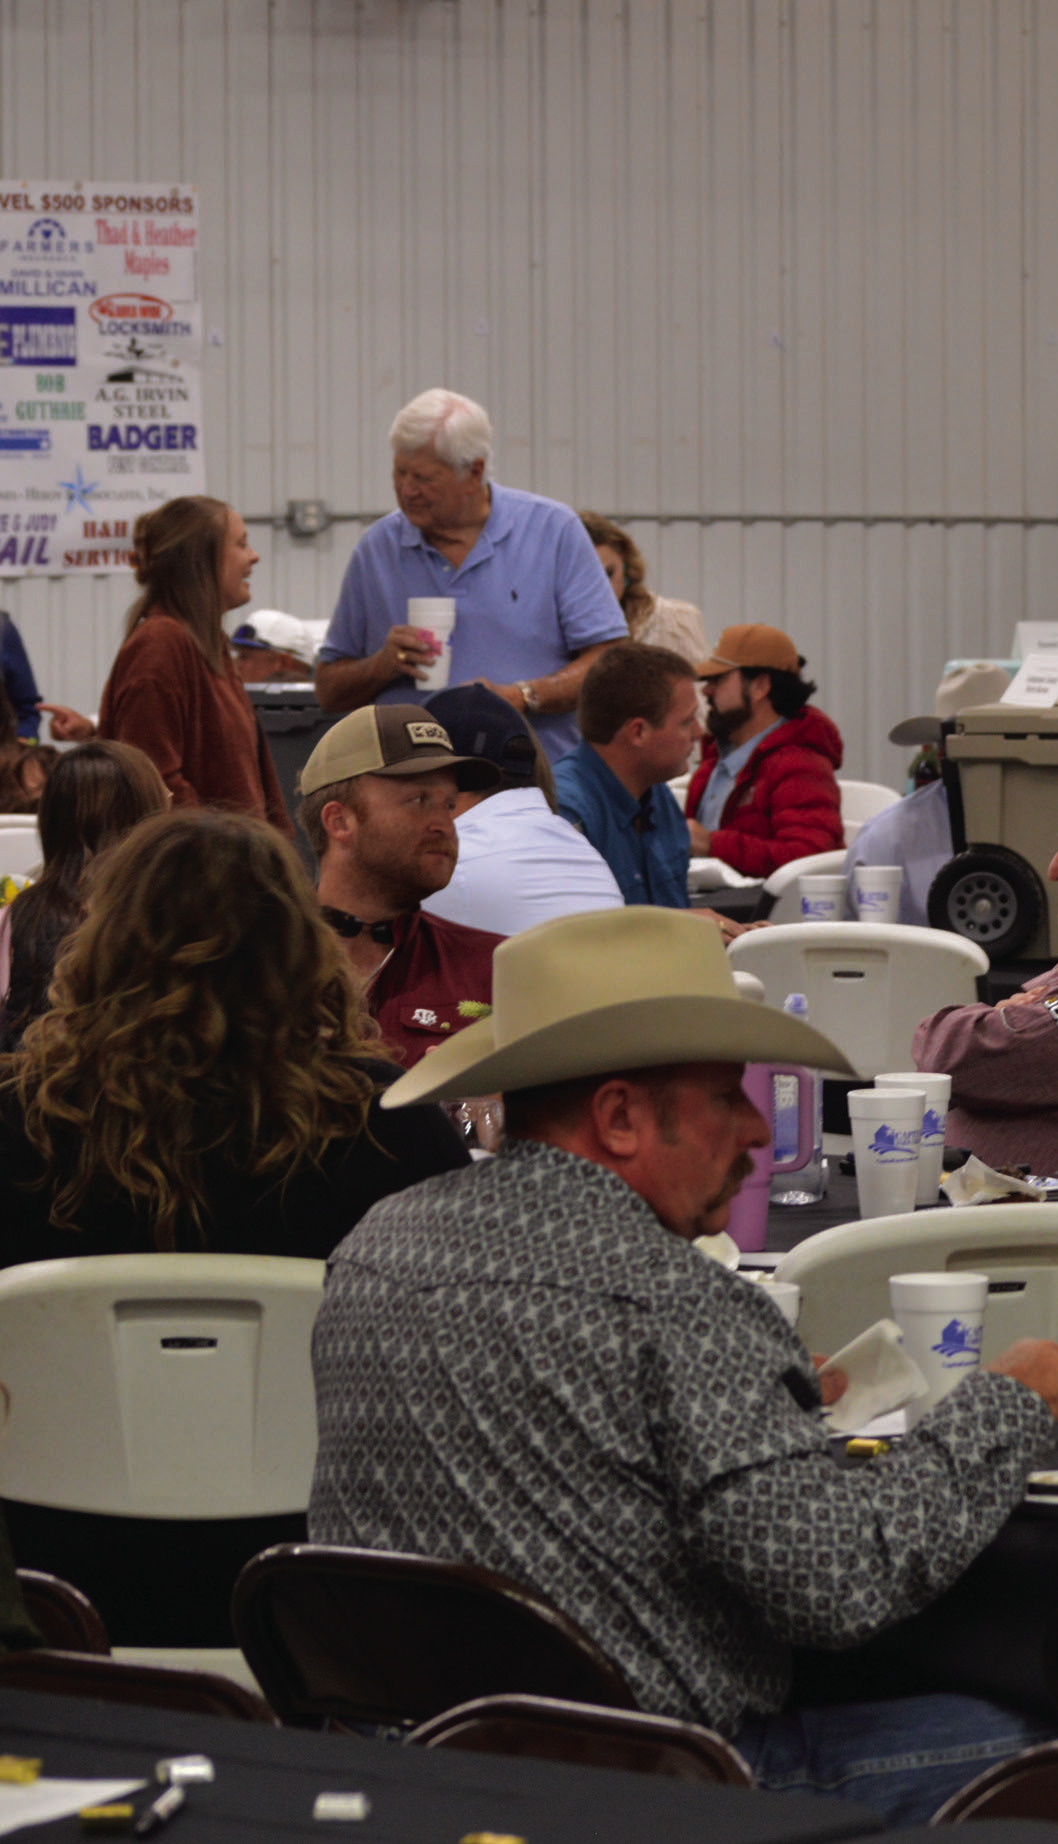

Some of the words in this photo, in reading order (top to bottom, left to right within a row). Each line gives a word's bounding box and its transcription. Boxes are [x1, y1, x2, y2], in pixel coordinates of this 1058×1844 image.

[0, 194, 35, 211] VEL
[41, 195, 85, 211] $500
[92, 196, 193, 214] SPONSORS
[0, 281, 97, 297] MILLICAN
[99, 321, 192, 336] LOCKSMITH
[136, 387, 190, 402] IRVIN
[113, 405, 172, 419] STEEL
[87, 424, 197, 450] BADGER
